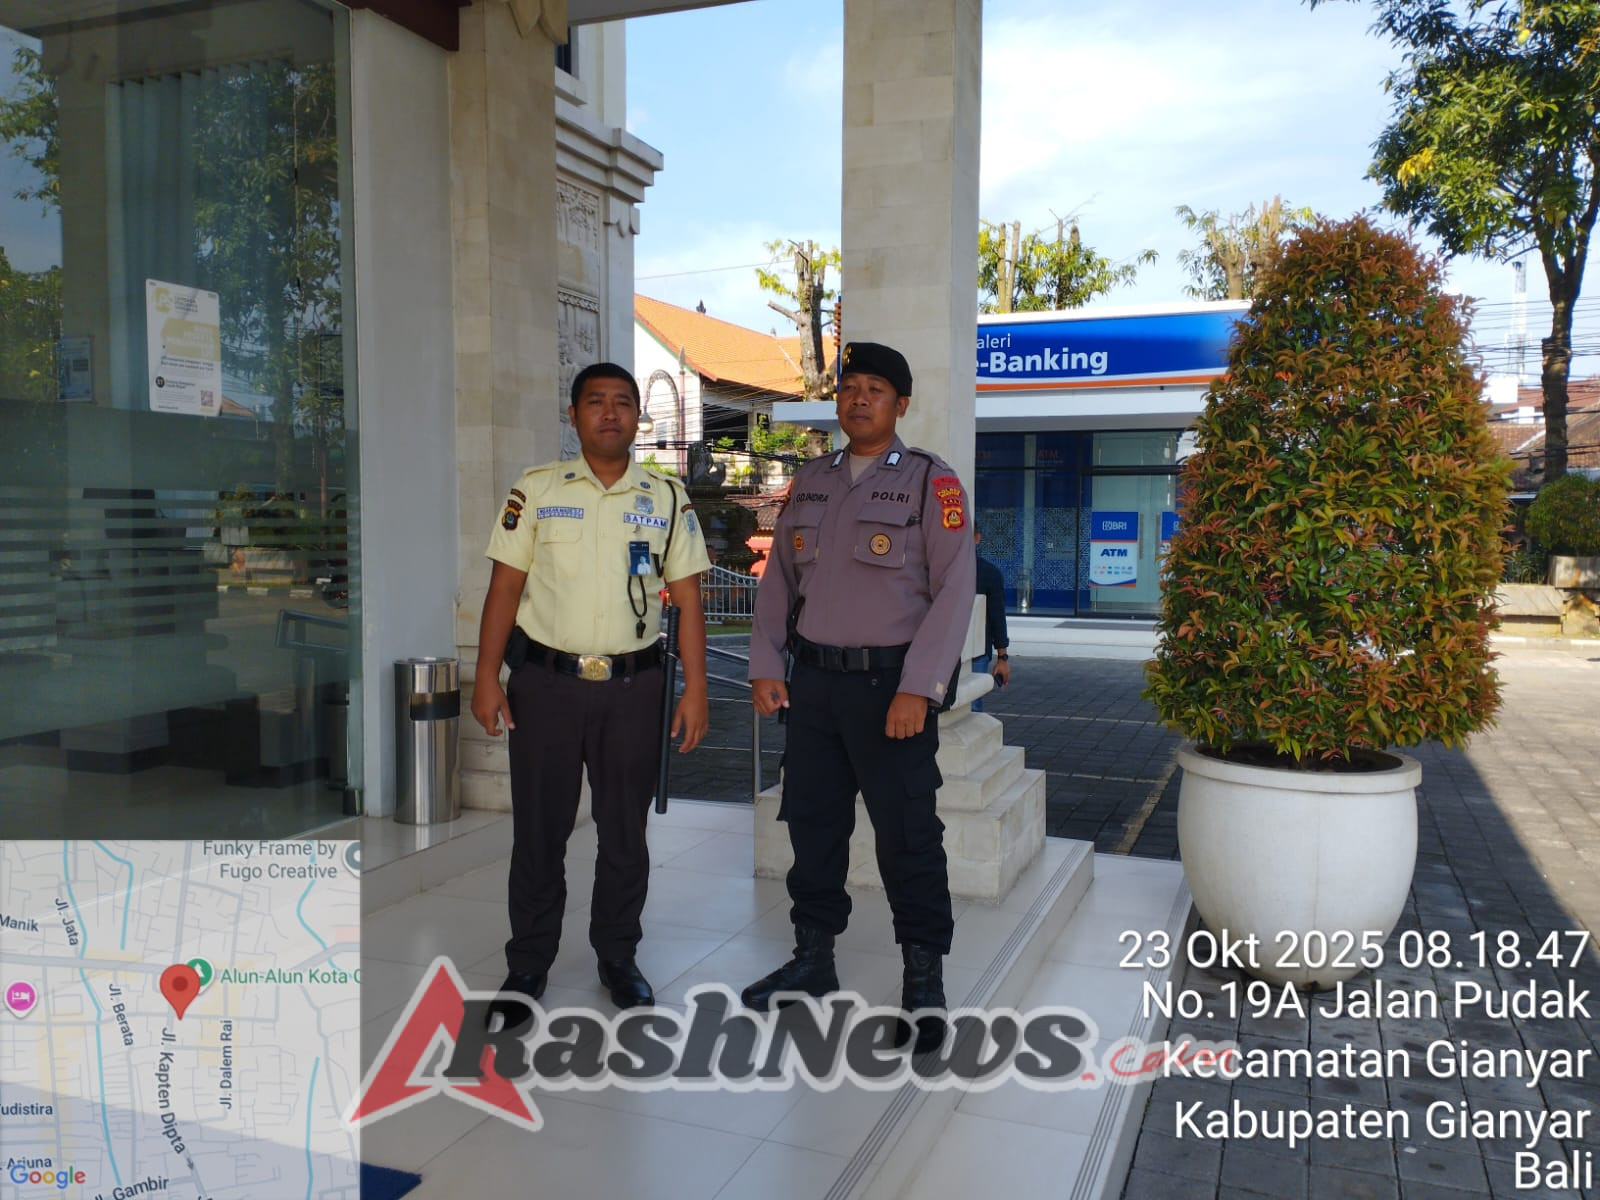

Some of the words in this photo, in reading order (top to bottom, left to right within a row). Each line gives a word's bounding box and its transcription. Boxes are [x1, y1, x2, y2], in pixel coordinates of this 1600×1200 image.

[976, 332, 1011, 349] aleri
[976, 347, 1108, 375] -Banking
[871, 491, 911, 504] POLRI
[625, 513, 668, 529] SATPAM
[1100, 548, 1128, 557] ATM
